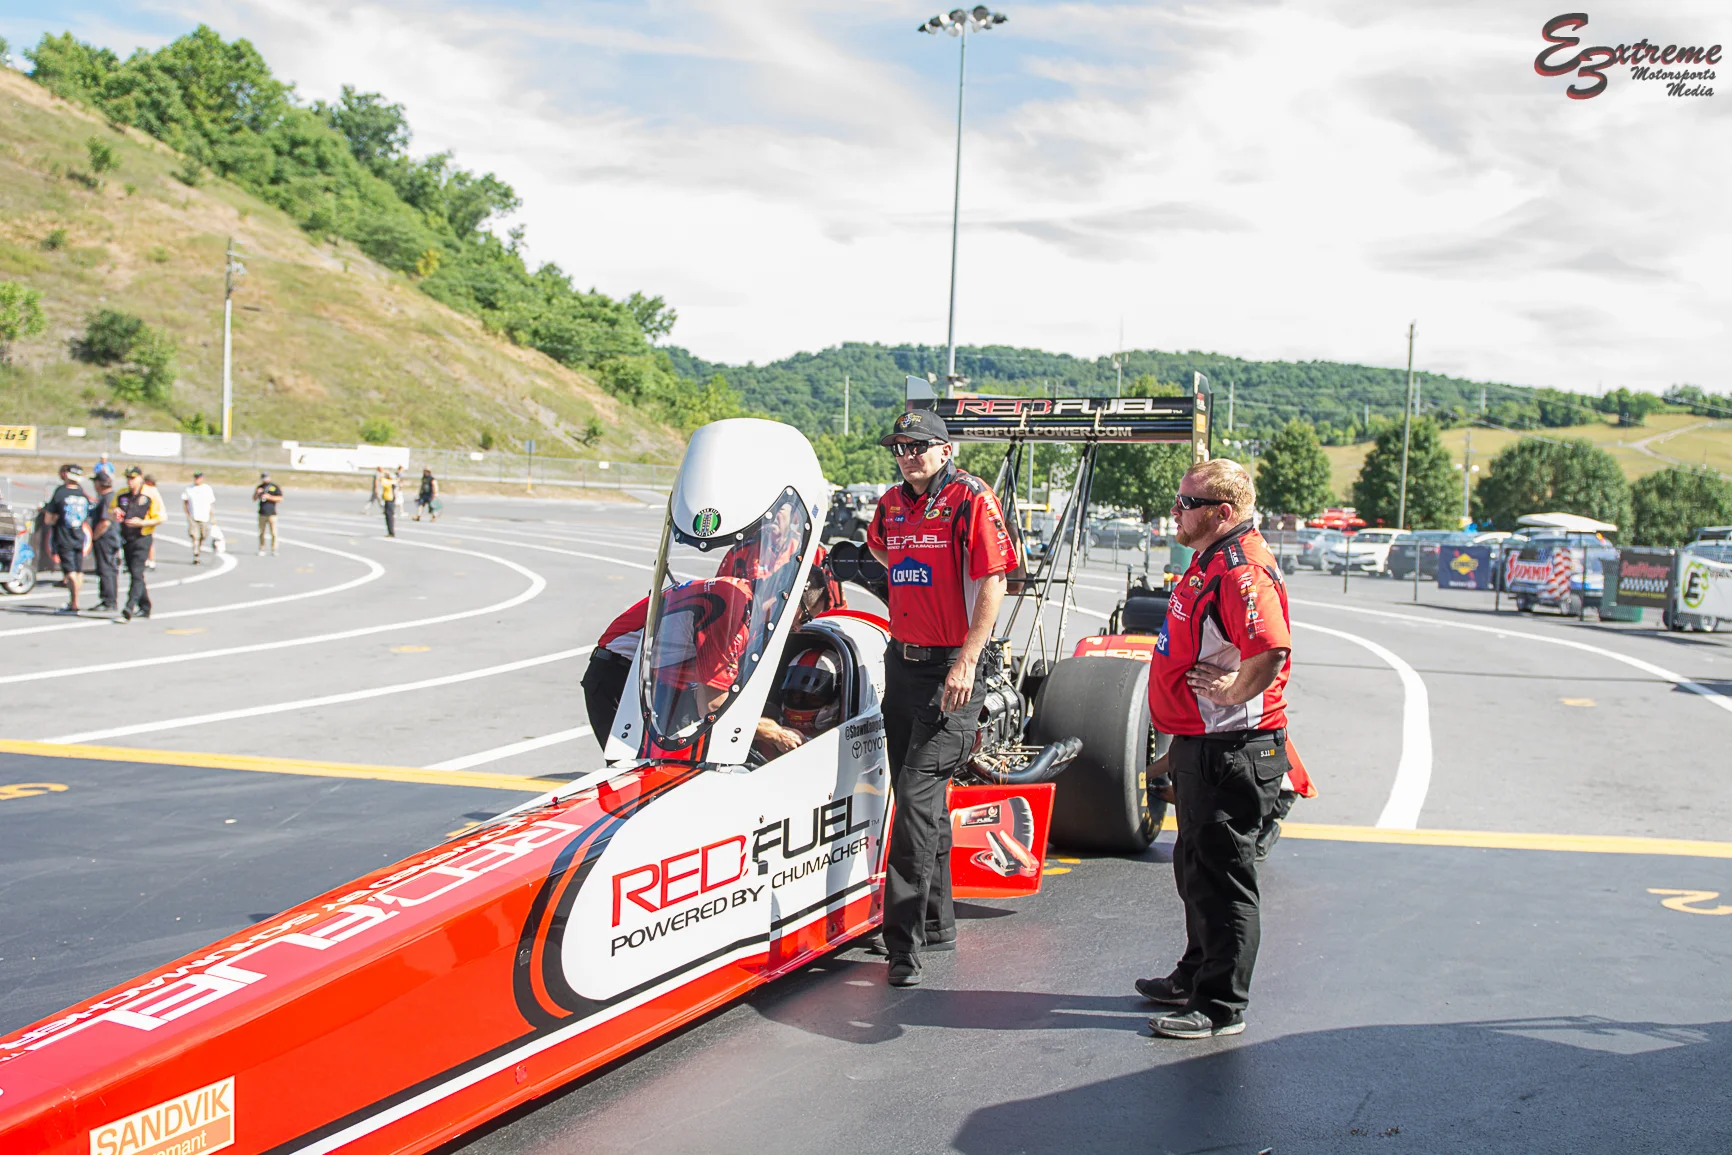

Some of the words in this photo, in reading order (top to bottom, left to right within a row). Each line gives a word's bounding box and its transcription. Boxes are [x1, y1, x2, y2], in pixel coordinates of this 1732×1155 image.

[963, 427, 1132, 437] REDFUELPOWER.COM
[892, 568, 928, 584] LOWE'S
[611, 896, 728, 957] POWERED
[731, 885, 765, 908] BY
[97, 1083, 230, 1155] SANDVIK
